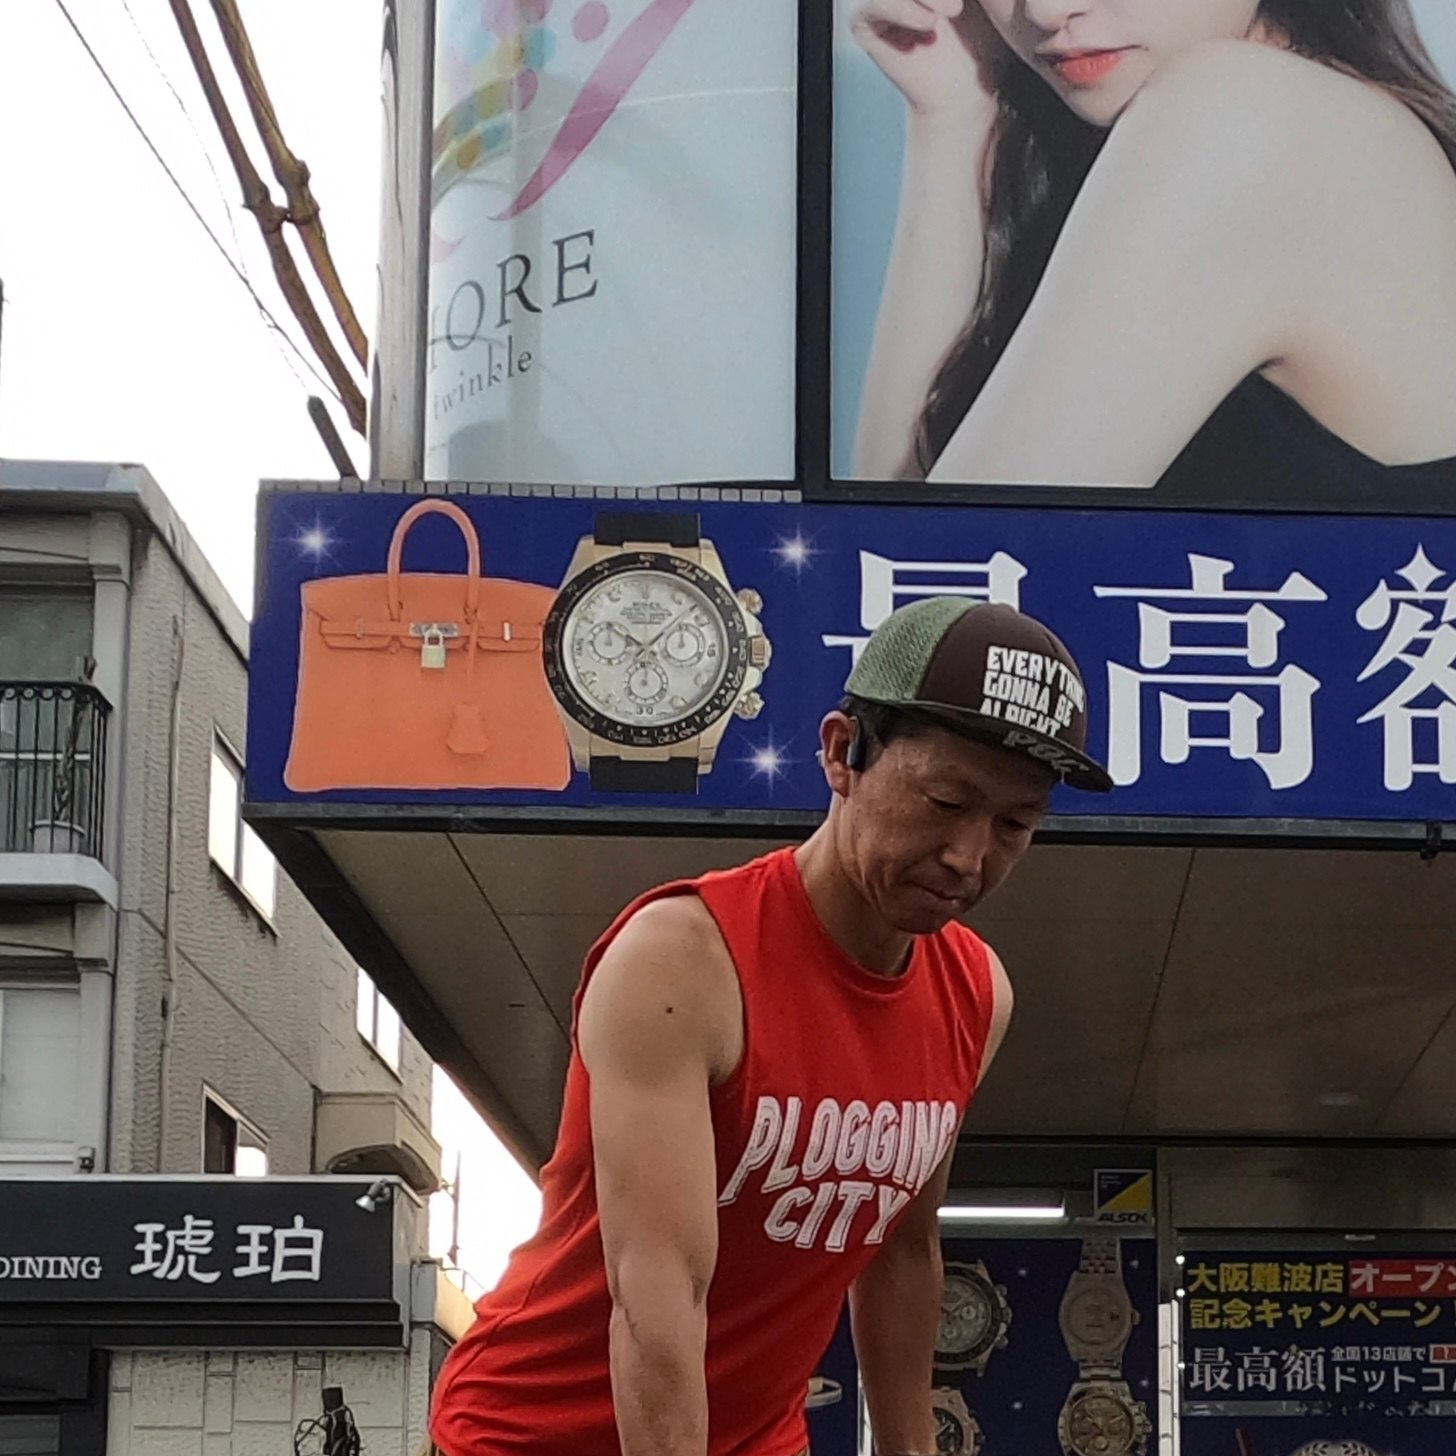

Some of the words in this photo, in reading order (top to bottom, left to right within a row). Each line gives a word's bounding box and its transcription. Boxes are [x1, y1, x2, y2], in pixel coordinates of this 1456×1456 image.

[430, 229, 598, 374] ORE
[982, 670, 1051, 715] GONNA
[1054, 693, 1075, 728] BE
[763, 1179, 912, 1253] CITY
[130, 1214, 324, 1284] 琥珀
[1187, 1262, 1344, 1293] 大阪難波店
[1189, 1345, 1327, 1393] 最高額
